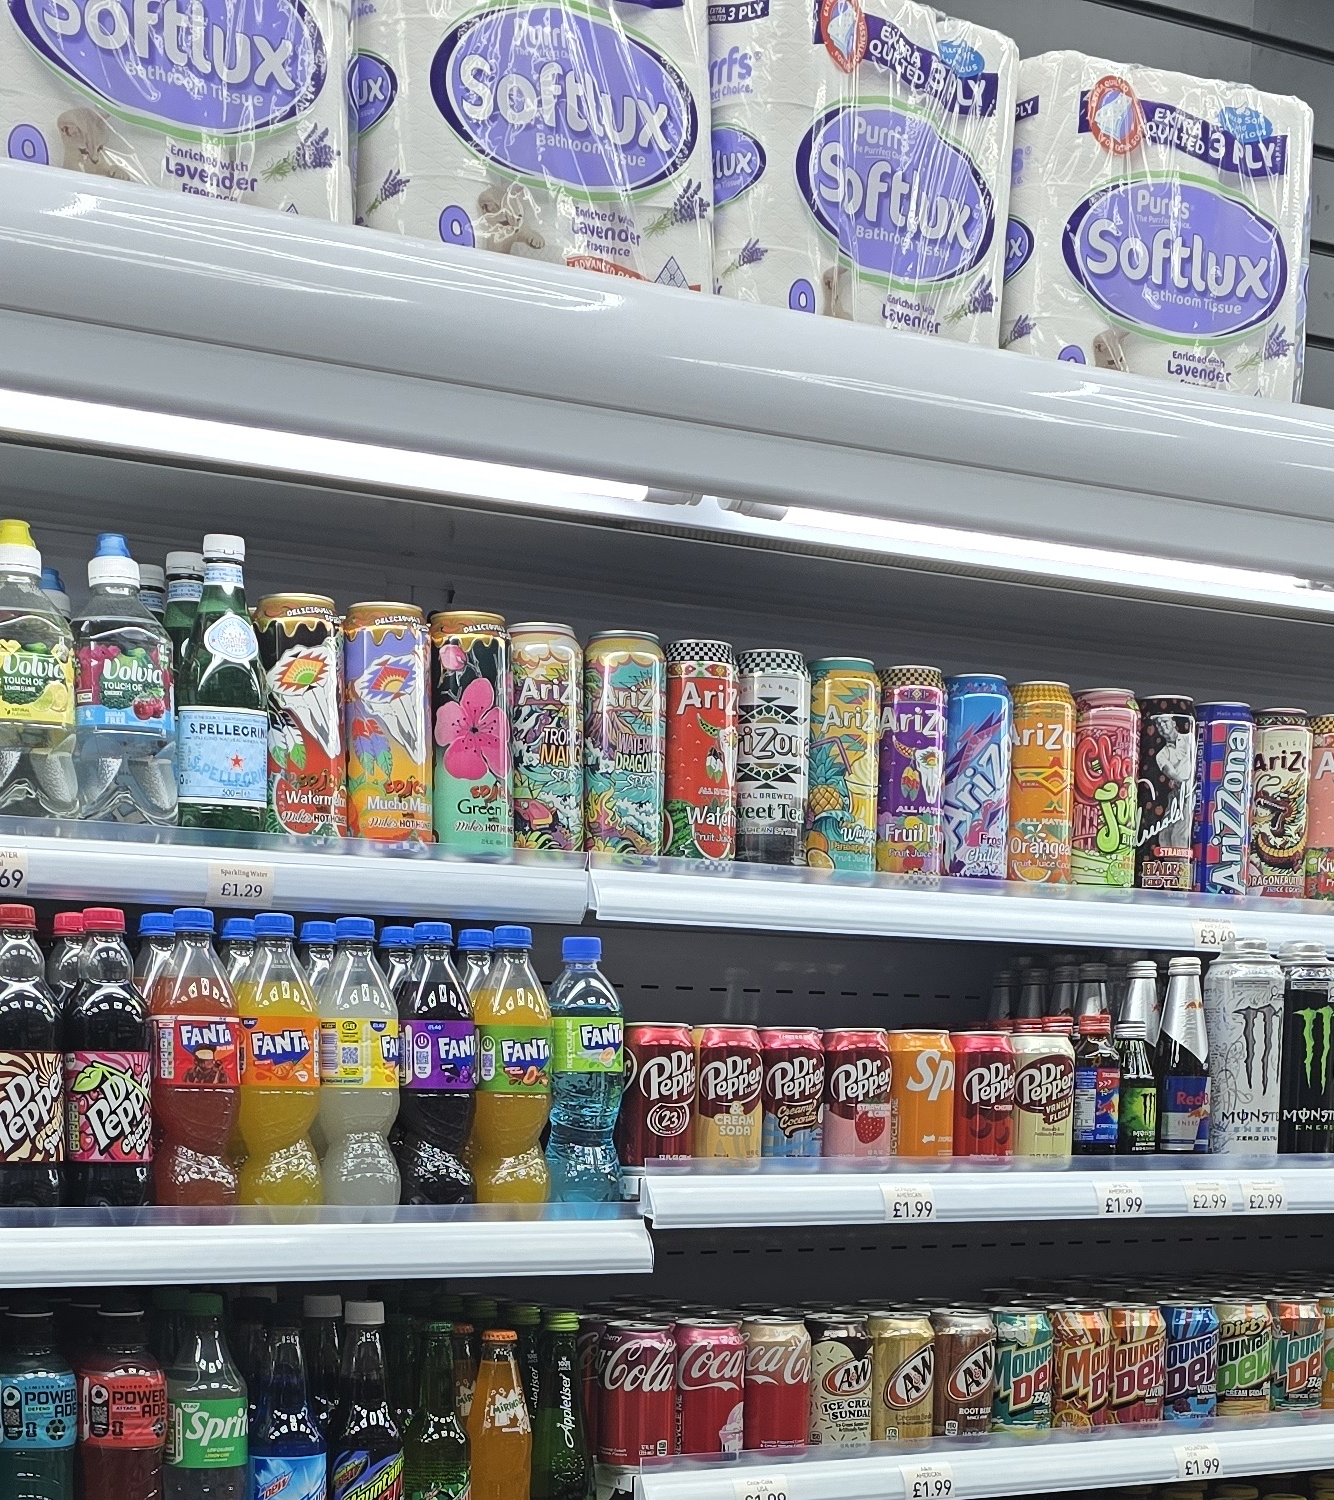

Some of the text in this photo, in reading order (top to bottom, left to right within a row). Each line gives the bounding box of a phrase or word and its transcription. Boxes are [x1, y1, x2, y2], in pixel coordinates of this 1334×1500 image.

[460, 54, 671, 153] Softlux
[170, 145, 248, 172] Enriched with
[1209, 134, 1276, 169] 3 PLY
[166, 156, 258, 192] Lavender
[570, 216, 641, 247] Lavender
[586, 239, 631, 258] Fragrance
[1087, 219, 1269, 298] Softlux
[1145, 289, 1242, 316] Bathroom Tissue
[1167, 358, 1231, 383] Lavender
[1212, 728, 1249, 894] AriZZona
[221, 868, 268, 878] Sparkling Water
[221, 882, 263, 898] £1.29
[180, 1025, 233, 1048] FANTA
[252, 1032, 311, 1055] FANTA
[656, 1106, 681, 1128] 23
[715, 1115, 755, 1125] CREAM
[719, 1125, 752, 1136] SODA
[892, 1201, 933, 1218] £1.99
[1105, 1197, 1143, 1214] £1.99
[1193, 1194, 1227, 1210] £2.99
[1248, 1194, 1283, 1210] £2.99
[564, 1363, 575, 1448] Appletiser
[1185, 1458, 1220, 1475] £1.99
[913, 1481, 952, 1497] £1.99
